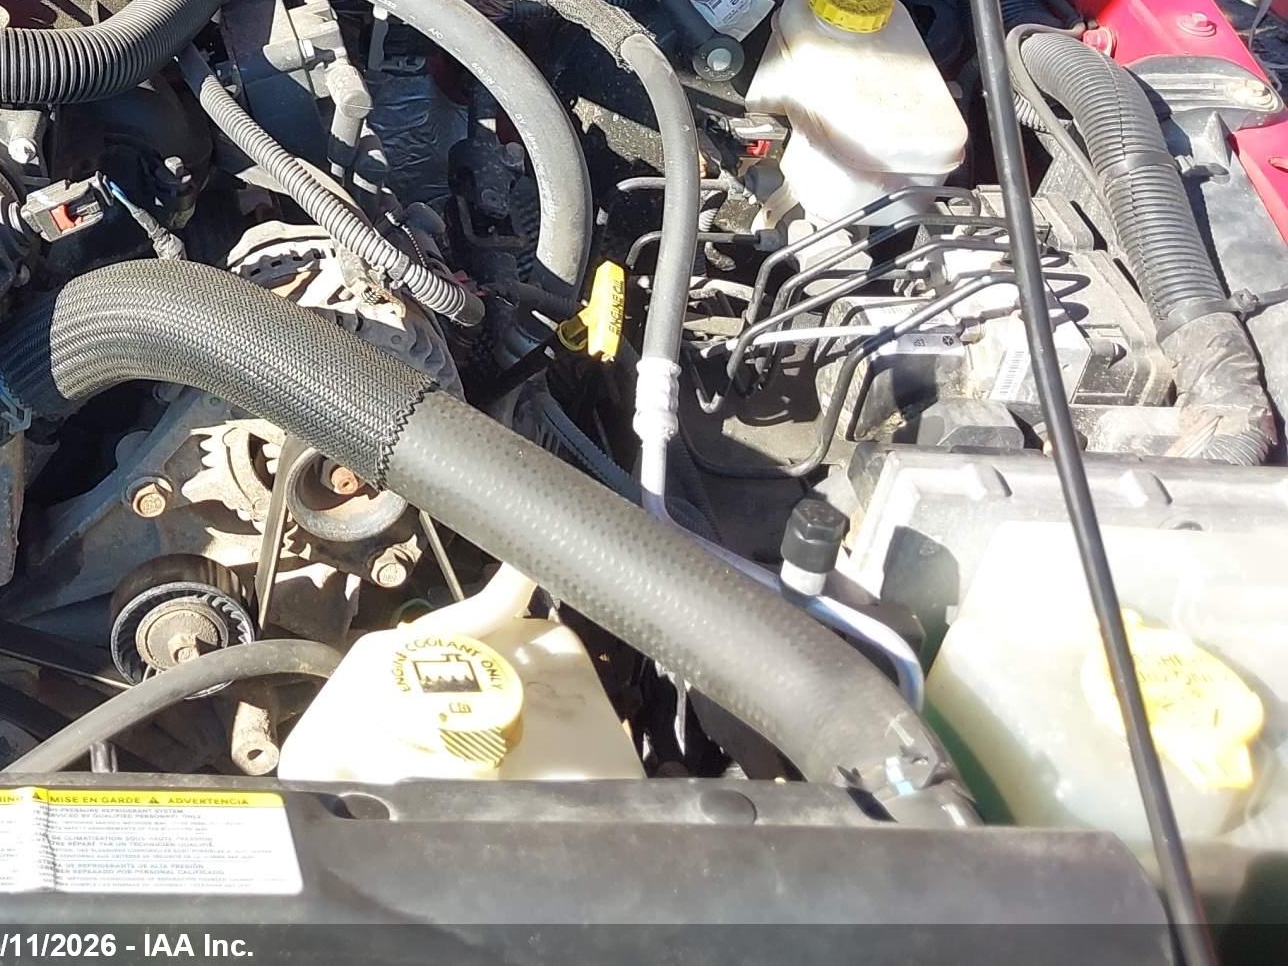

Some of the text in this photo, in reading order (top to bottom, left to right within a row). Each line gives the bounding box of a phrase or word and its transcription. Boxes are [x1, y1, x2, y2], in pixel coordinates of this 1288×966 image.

[608, 280, 624, 336] ENGINE OIL
[404, 638, 480, 656] COOLANT
[481, 659, 504, 691] ONLY
[101, 796, 141, 804] GARDE
[168, 797, 249, 805] ADVERTENCIA
